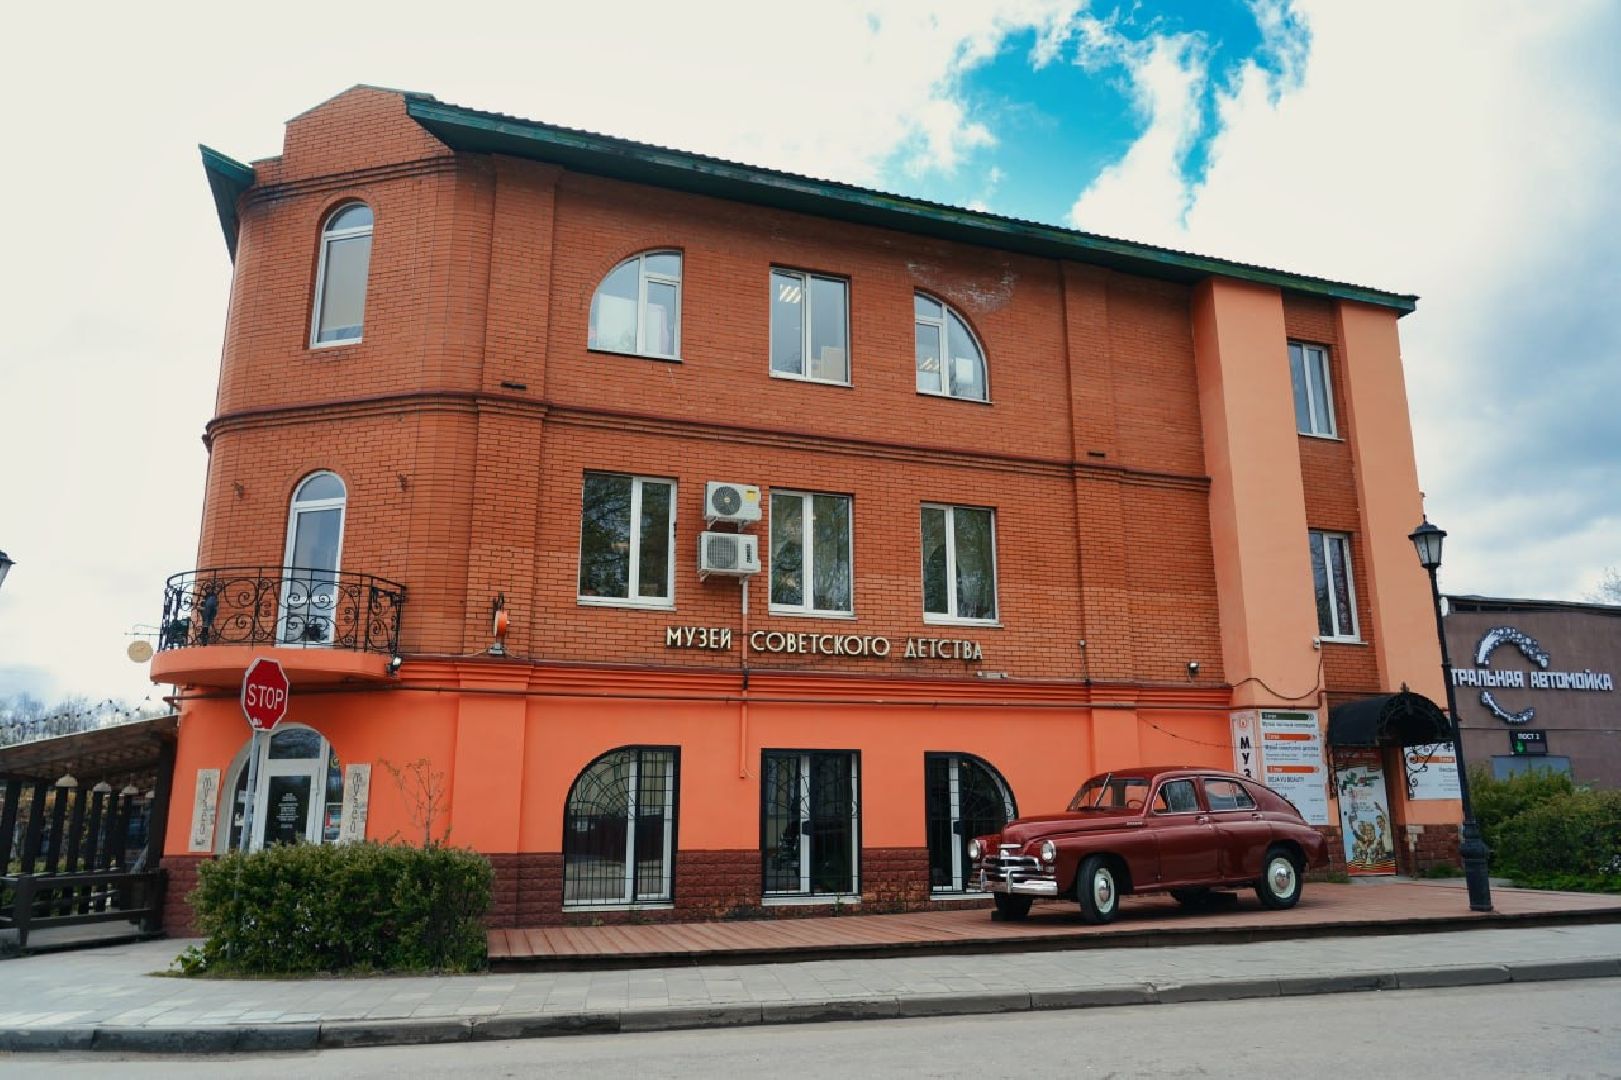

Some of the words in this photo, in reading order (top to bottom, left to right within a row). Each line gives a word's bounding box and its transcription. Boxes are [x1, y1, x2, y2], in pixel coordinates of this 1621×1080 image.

[666, 626, 732, 649] МУЗЕЙ
[751, 630, 891, 656] СОВЕТСКОГО
[904, 638, 983, 660] ДЕТСТВА
[1450, 668, 1525, 687] ТРАЛЬНАЯ
[1531, 669, 1614, 691] АВТОМОЙКА
[247, 683, 284, 710] STOP
[1240, 735, 1252, 778] МУЗ
